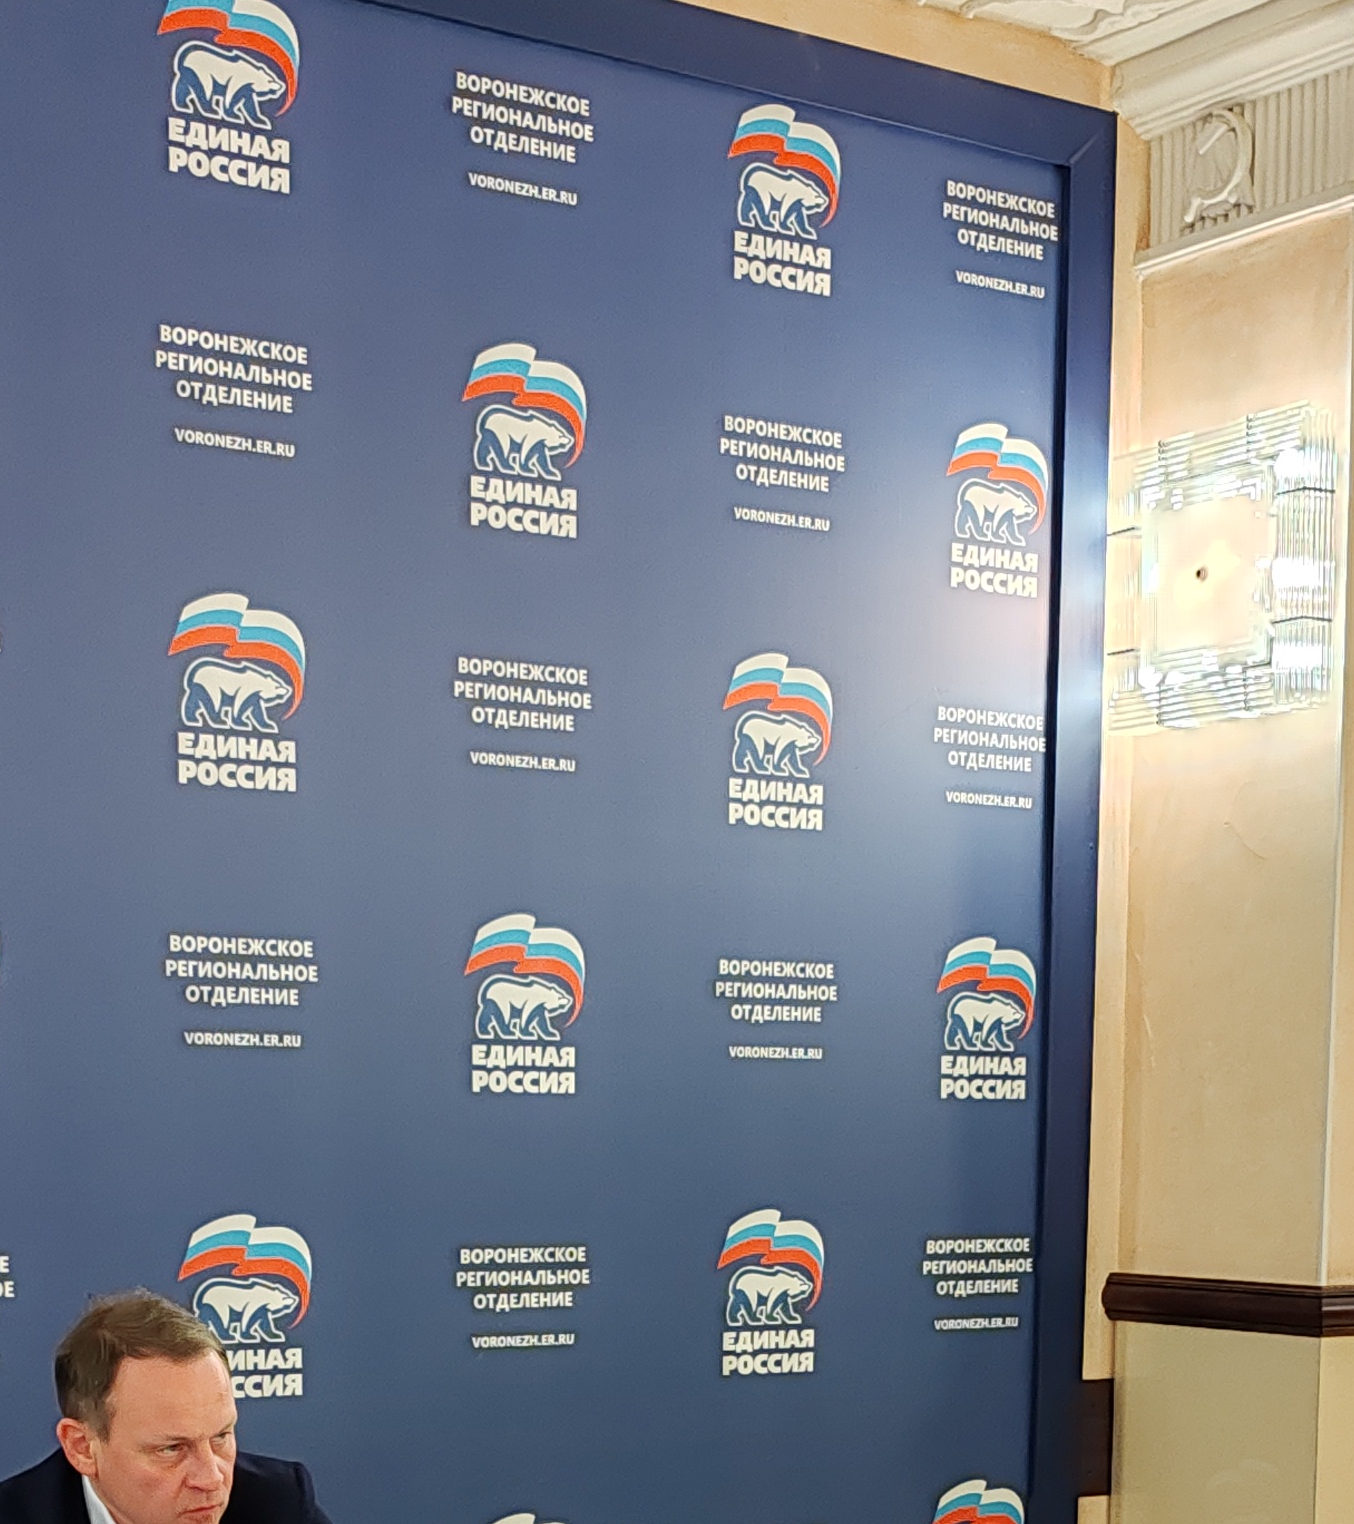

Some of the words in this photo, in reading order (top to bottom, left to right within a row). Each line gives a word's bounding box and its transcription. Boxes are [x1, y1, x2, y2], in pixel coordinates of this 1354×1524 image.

[456, 71, 590, 117] ВОРОНЕЖСКОЕ
[451, 95, 594, 143] РЕГИОНАЛЬНОЕ
[167, 116, 290, 164] ЕДИНАЯ
[470, 125, 577, 164] ОТДЕЛЕНИЕ
[168, 145, 290, 195] РОССИЯ
[468, 172, 578, 206] VORONEZH.ER.RU
[947, 179, 1055, 219] ВОРОНЕЖСКОЕ
[942, 201, 1059, 242] РЕГИОНАЛЬНОЕ
[733, 230, 832, 270] ЕДИНАЯ
[957, 228, 1044, 261] ОТДЕЛЕНИЕ
[733, 256, 832, 297] РОССИЯ
[955, 269, 1046, 299] VORONEZH.ER.RU
[159, 324, 308, 365] ВОРОНЕЖСКОЕ
[155, 349, 313, 391] РЕГИОНАЛЬНОЕ
[176, 379, 293, 414] ОТДЕЛЕНИЕ
[174, 427, 296, 458] VORONEZH.ER.RU
[724, 415, 843, 449] ВОРОНЕЖСКОЕ
[720, 437, 846, 473] РЕГИОНАЛЬНОЕ
[735, 463, 830, 493] ОТДЕЛЕНИЕ
[470, 474, 578, 512] ЕДИНАЯ
[470, 501, 578, 539] РОССИЯ
[733, 506, 831, 532] VORONEZH.ER.RU
[951, 543, 1038, 573] ЕДИНАЯ
[950, 566, 1038, 598] РОССИЯ
[458, 656, 588, 686] ВОРОНЕЖСКОЕ
[453, 680, 593, 710] РЕГИОНАЛЬНОЕ
[471, 706, 575, 732] ОТДЕЛЕНИЕ
[937, 705, 1044, 731] ВОРОНЕЖСКОЕ
[177, 731, 297, 764] ЕДИНАЯ
[933, 726, 1046, 753] РЕГИОНАЛЬНОЕ
[469, 751, 576, 772] VORONEZH.ER.RU
[947, 749, 1032, 773] ОТДЕЛЕНИЕ
[177, 759, 297, 792] РОССИЯ
[728, 777, 824, 806] ЕДИНАЯ
[945, 790, 1033, 809] VORONEZH.ER.RU
[728, 802, 824, 831] РОССИЯ
[169, 934, 314, 958] ВОРОНЕЖСКОЕ
[165, 959, 319, 983] РЕГИОНАЛЬНОЕ
[719, 958, 835, 980] ВОРОНЕЖСКОЕ
[185, 984, 300, 1007] ОТДЕЛЕНИЕ
[715, 981, 838, 1002] РЕГИОНАЛЬНОЕ
[730, 1003, 822, 1024] ОТДЕЛЕНИЕ
[184, 1031, 302, 1048] VORONEZH.ER.RU
[728, 1045, 823, 1060] VORONEZH.ER.RU
[471, 1044, 576, 1070] ЕДИНАЯ
[940, 1054, 1027, 1078] ЕДИНАЯ
[471, 1069, 576, 1095] РОССИЯ
[940, 1078, 1026, 1100] РОССИЯ
[460, 1246, 587, 1265] ВОРОНЕЖСКОЕ
[925, 1237, 1030, 1255] ВОРОНЕЖСКОЕ
[456, 1268, 591, 1287] РЕГИОНАЛЬНОЕ
[922, 1257, 1033, 1276] РЕГИОНАЛЬНОЕ
[936, 1278, 1019, 1298] ОТДЕЛЕНИЕ
[473, 1291, 573, 1313] ОТДЕЛЕНИЕ
[933, 1316, 1019, 1331] VORONEZH.ER.RU
[471, 1333, 575, 1349] VORONEZH.ER.RU
[722, 1328, 815, 1354] ЕДИНАЯ
[226, 1348, 303, 1371] ИНАЯ
[722, 1351, 815, 1376] РОССИЯ
[231, 1373, 303, 1398] ССИЯ
